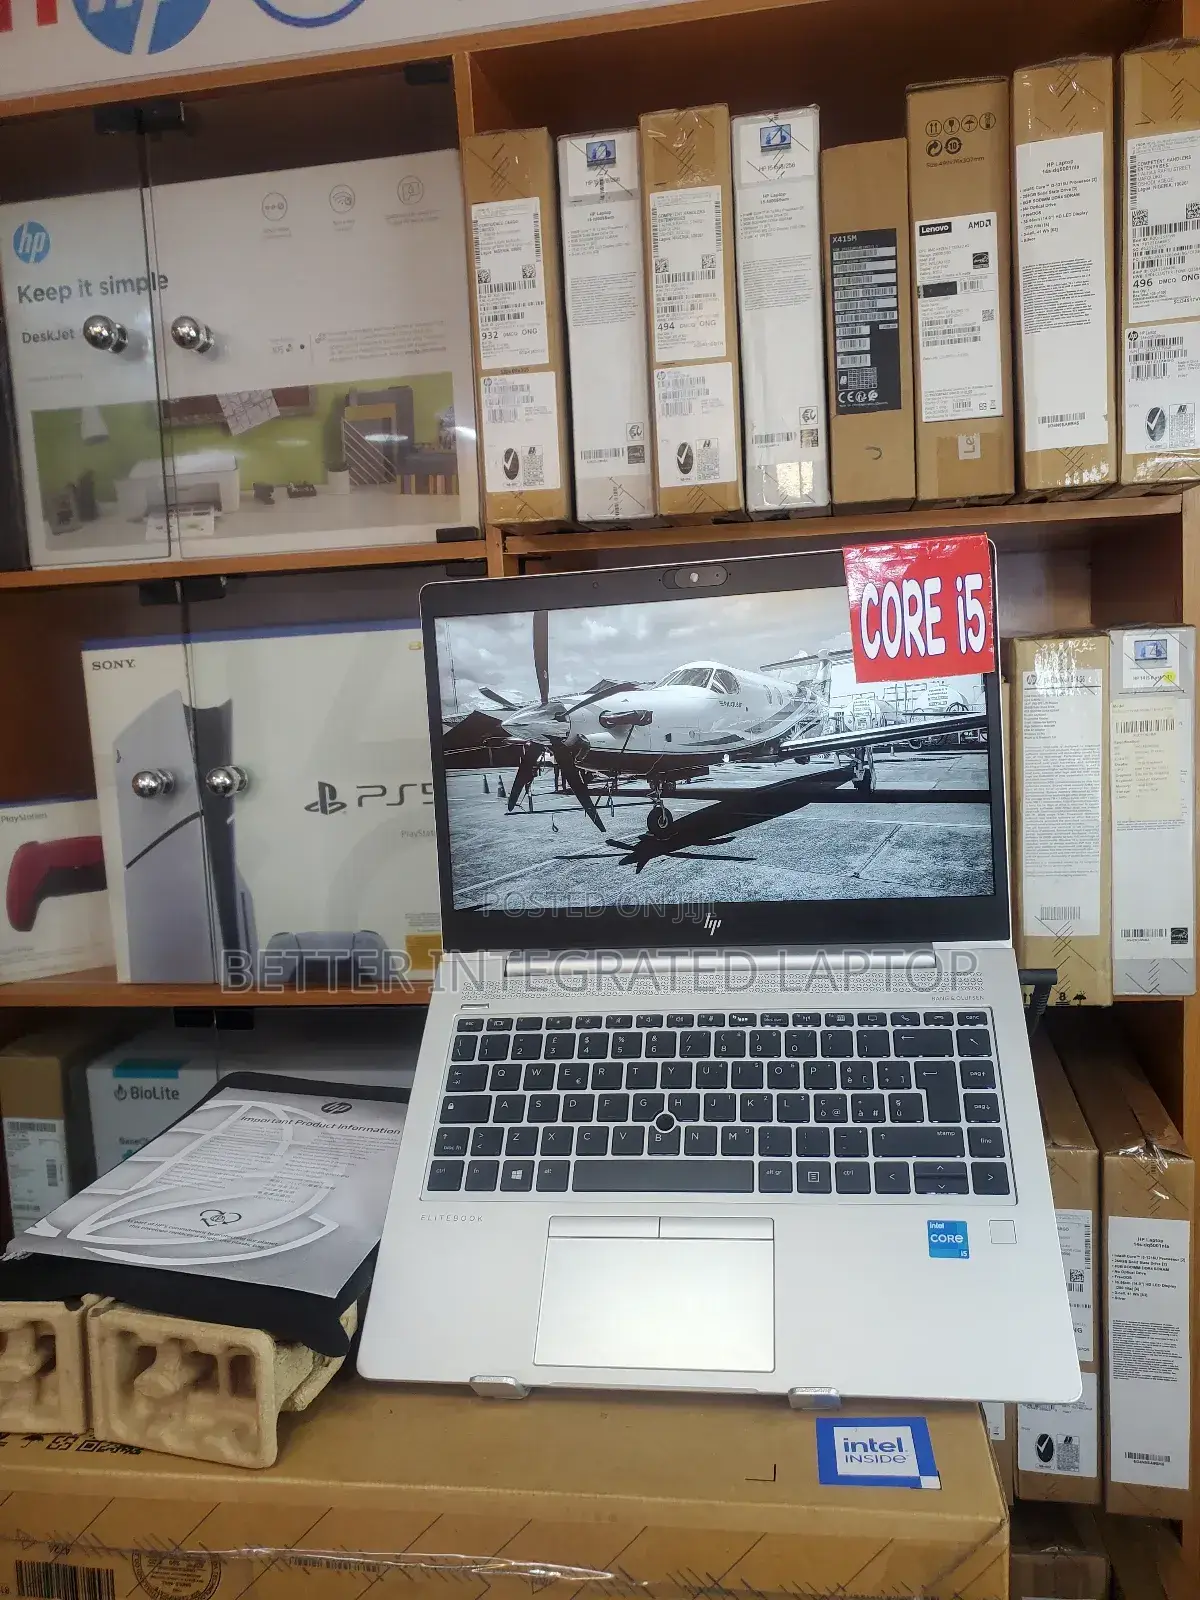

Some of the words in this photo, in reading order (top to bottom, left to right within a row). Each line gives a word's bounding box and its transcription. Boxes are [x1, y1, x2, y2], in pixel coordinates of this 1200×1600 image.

[949, 141, 957, 150] 10
[1138, 158, 1165, 166] COMPETENT
[921, 224, 950, 235] Lenovo
[968, 220, 985, 230] AMD
[16, 222, 48, 263] hp
[832, 235, 858, 243] X415M
[1133, 278, 1153, 288] 496
[1181, 273, 1200, 282] ONG
[17, 284, 72, 304] Keep
[78, 278, 92, 297] it
[100, 271, 169, 296] simple
[657, 321, 675, 331] 494
[22, 328, 75, 344] DeskJet
[482, 331, 498, 340] 932
[860, 576, 946, 660] CORE
[955, 572, 986, 655] i5
[92, 659, 136, 671] SONY
[704, 912, 722, 936] hp
[497, 1069, 506, 1077] Q
[531, 1068, 542, 1076] W
[564, 1068, 571, 1076] E
[598, 1067, 605, 1076] R
[632, 1067, 639, 1075] T
[667, 1066, 675, 1075] Y
[702, 1066, 710, 1075] U
[774, 1066, 783, 1075] O
[810, 1066, 817, 1075] P
[130, 1086, 180, 1100] BioLite
[501, 1100, 509, 1108] A
[535, 1099, 542, 1108] S
[569, 1099, 577, 1108] D
[603, 1099, 611, 1107] F
[639, 1098, 648, 1107] G
[674, 1098, 682, 1107] H
[710, 1098, 716, 1107] J
[747, 1099, 754, 1107] K
[783, 1099, 790, 1108] L
[241, 1116, 293, 1126] Important
[295, 1119, 336, 1129] Product
[338, 1124, 401, 1134] Information
[512, 1132, 520, 1141] Z
[547, 1132, 556, 1141] X
[583, 1132, 591, 1141] C
[619, 1131, 627, 1140] V
[654, 1133, 663, 1143] B
[691, 1132, 699, 1141] N
[728, 1132, 738, 1141] M
[420, 1214, 483, 1222] ELITEBOOK
[843, 1437, 906, 1453] intel
